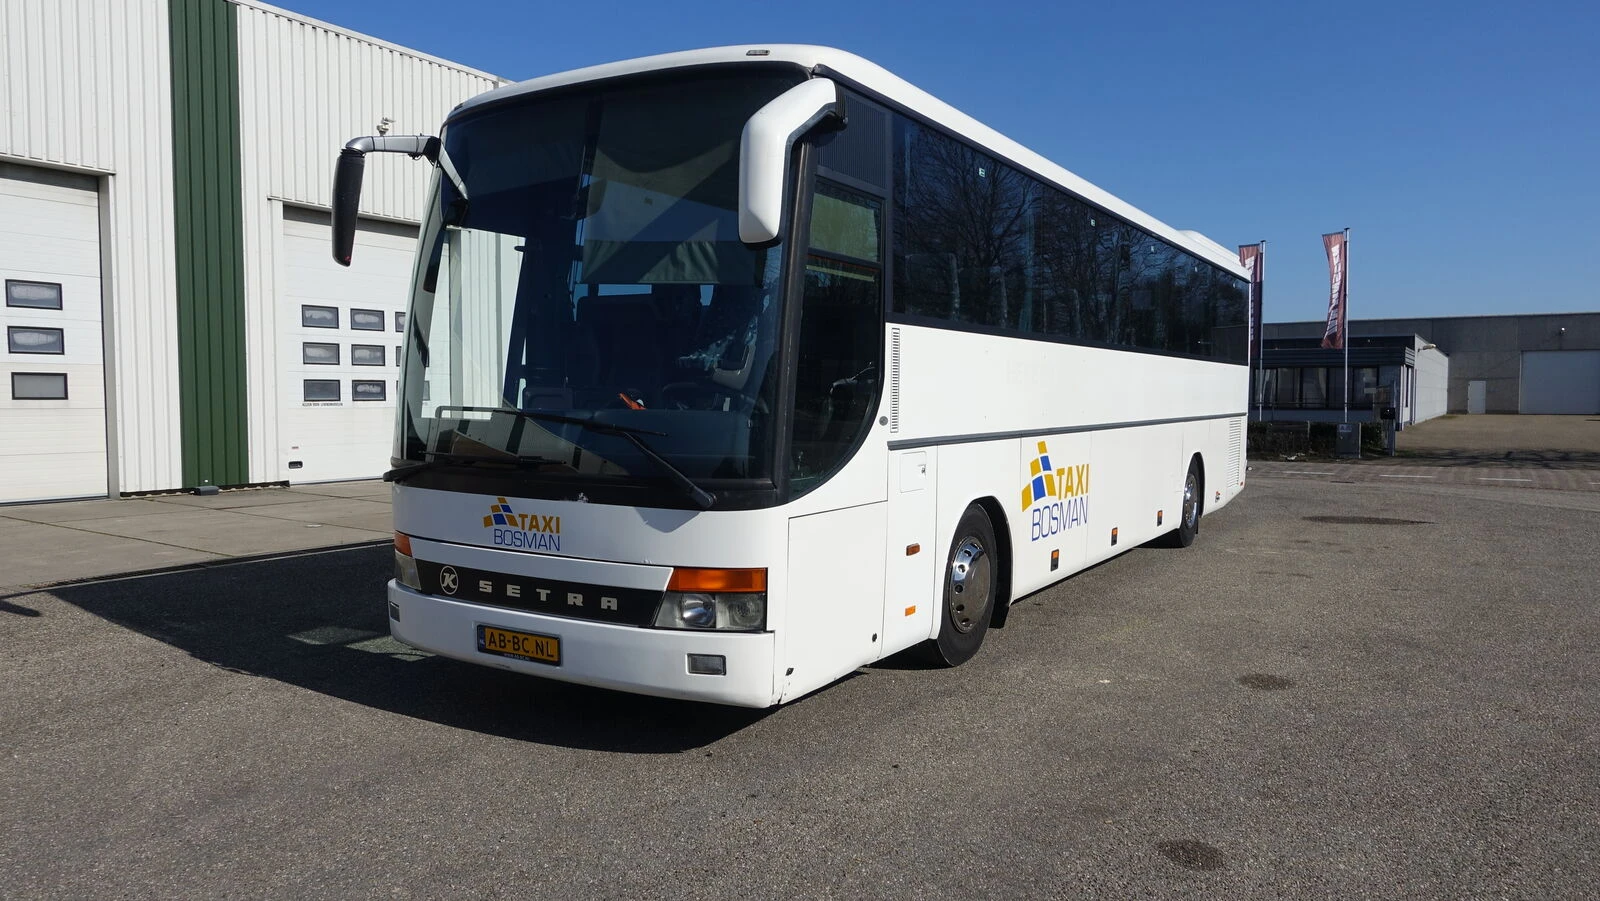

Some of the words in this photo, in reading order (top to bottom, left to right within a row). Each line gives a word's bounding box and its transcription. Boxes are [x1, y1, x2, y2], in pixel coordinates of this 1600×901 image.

[1056, 463, 1089, 501] TAXI
[518, 513, 560, 534] TAXI
[1031, 495, 1089, 542] BOSMAN
[494, 528, 560, 551] BOSMAN
[479, 580, 618, 611] SETRA
[488, 631, 555, 658] AB-BC.NL
